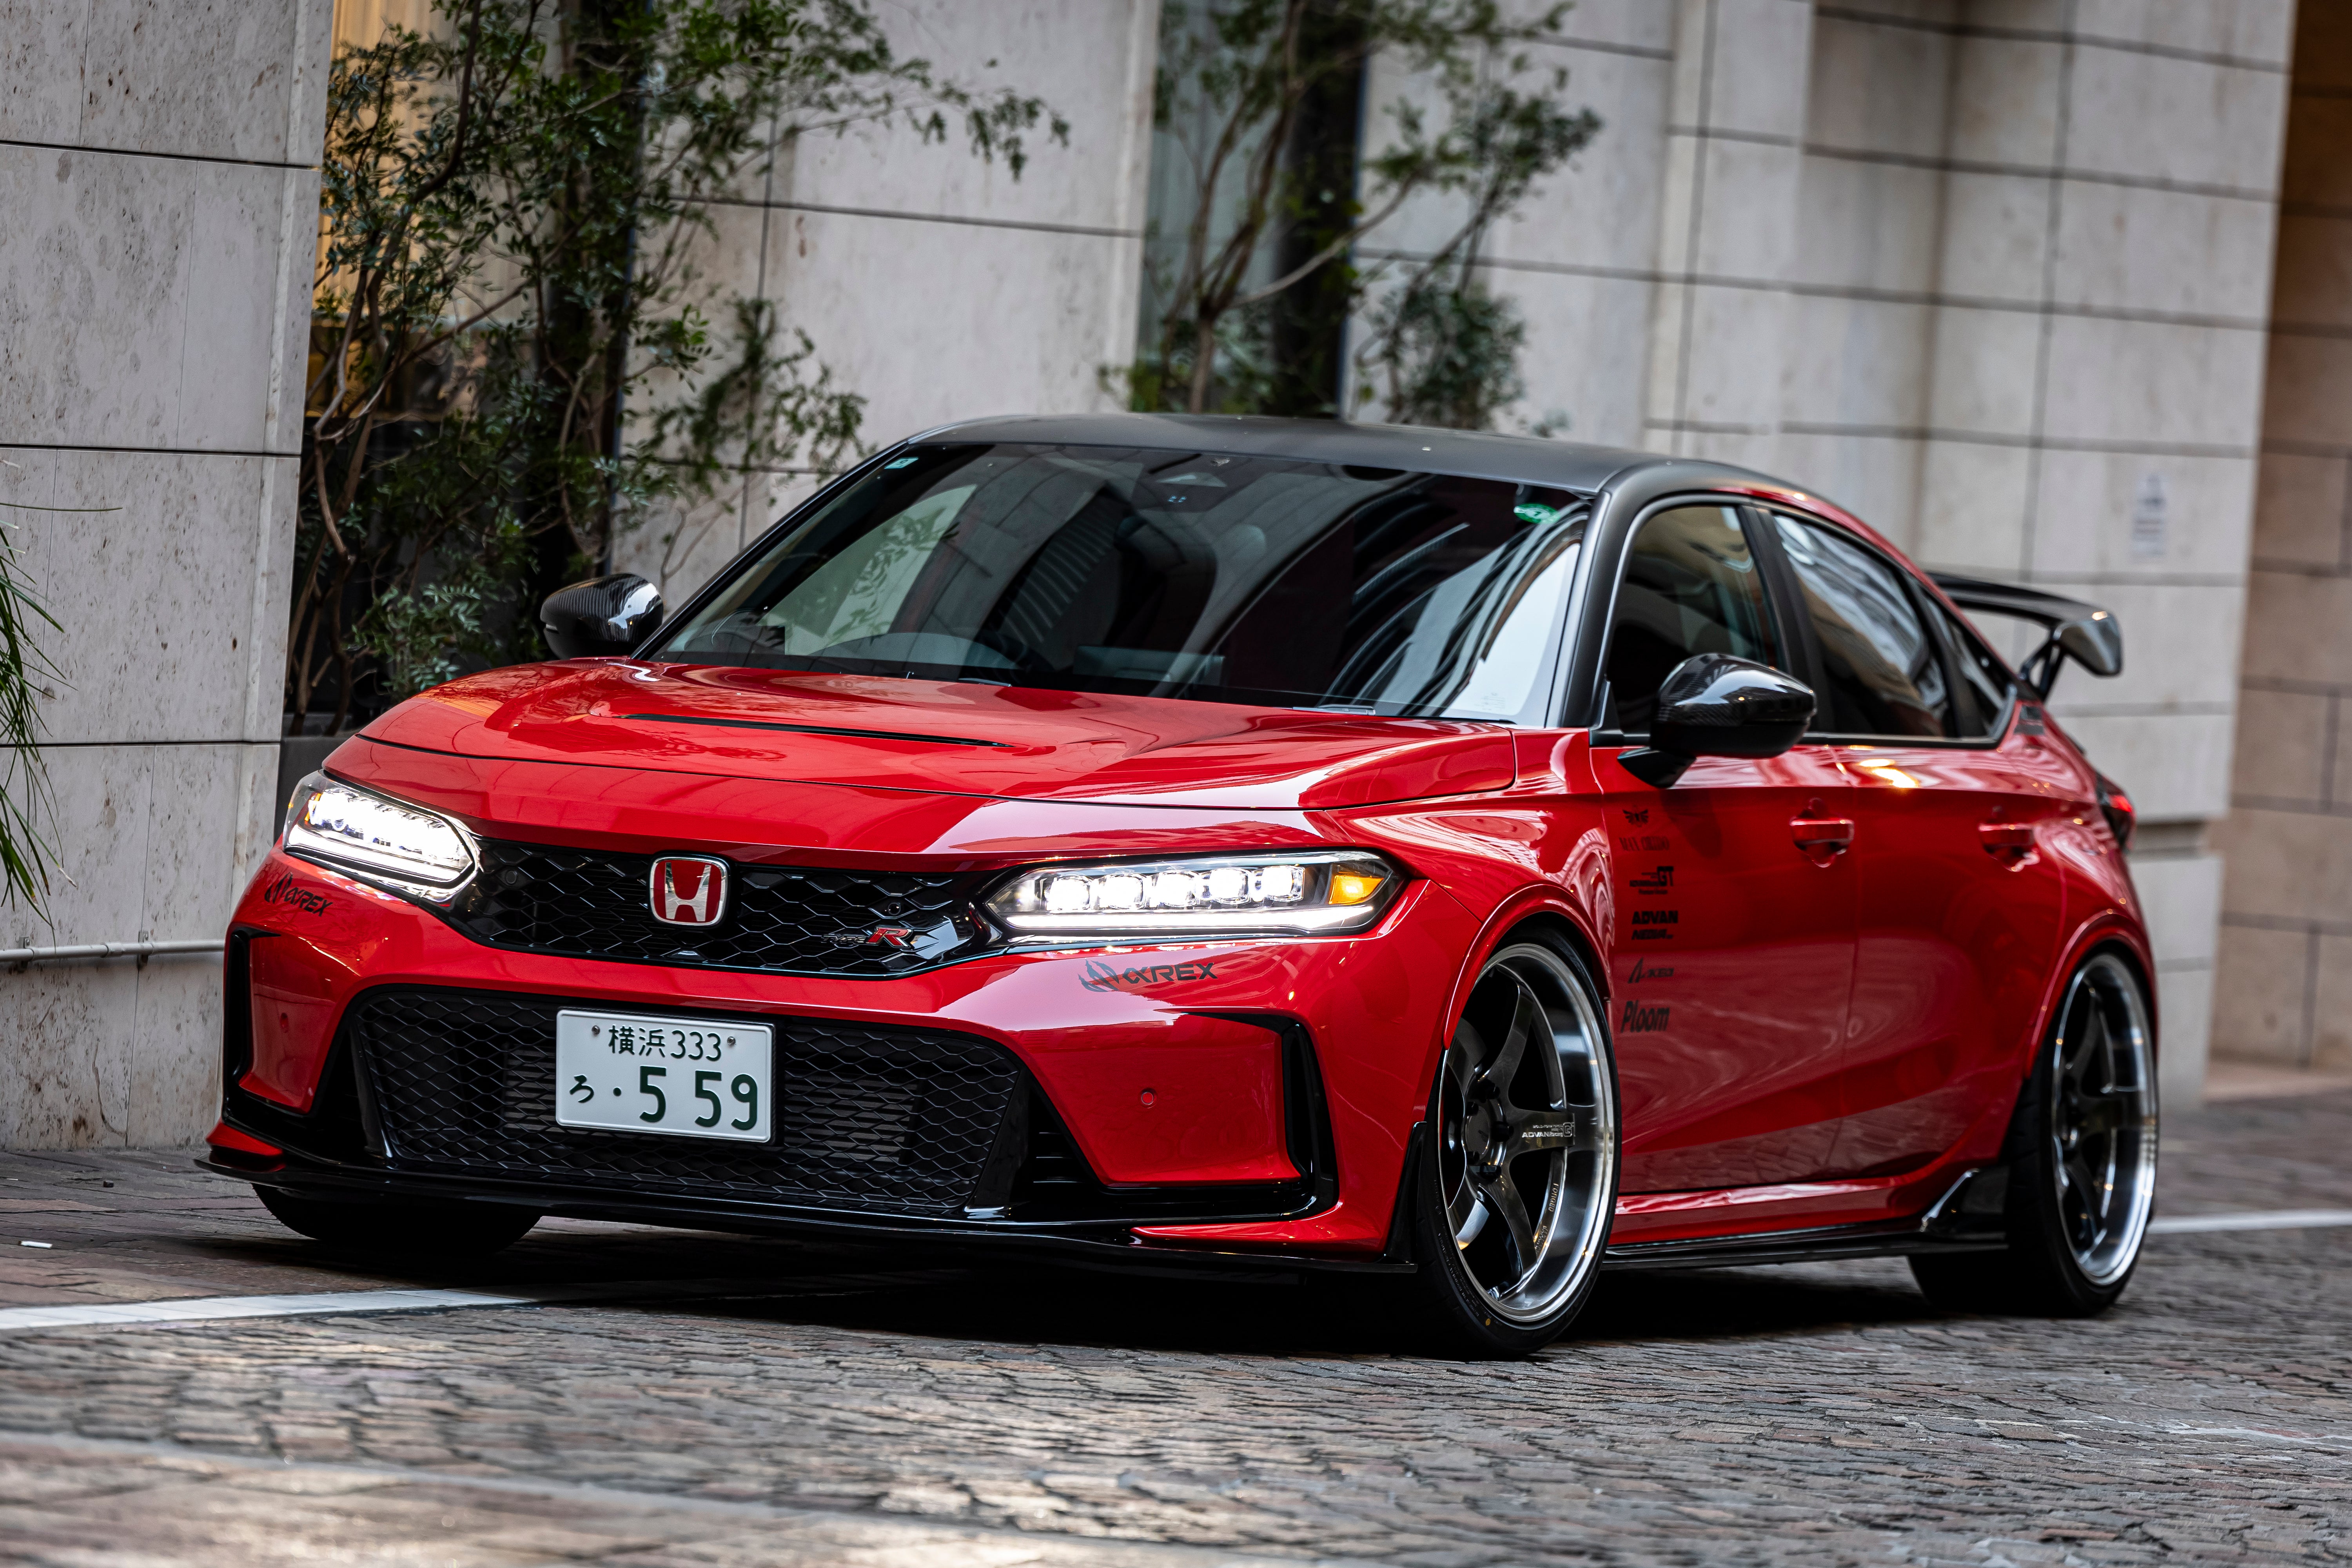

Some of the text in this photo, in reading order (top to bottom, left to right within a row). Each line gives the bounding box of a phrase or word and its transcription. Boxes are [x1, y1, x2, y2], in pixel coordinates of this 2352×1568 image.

[1632, 910, 1678, 924] ADVAN
[866, 927, 913, 949] R
[1621, 1000, 1670, 1033] Ploom
